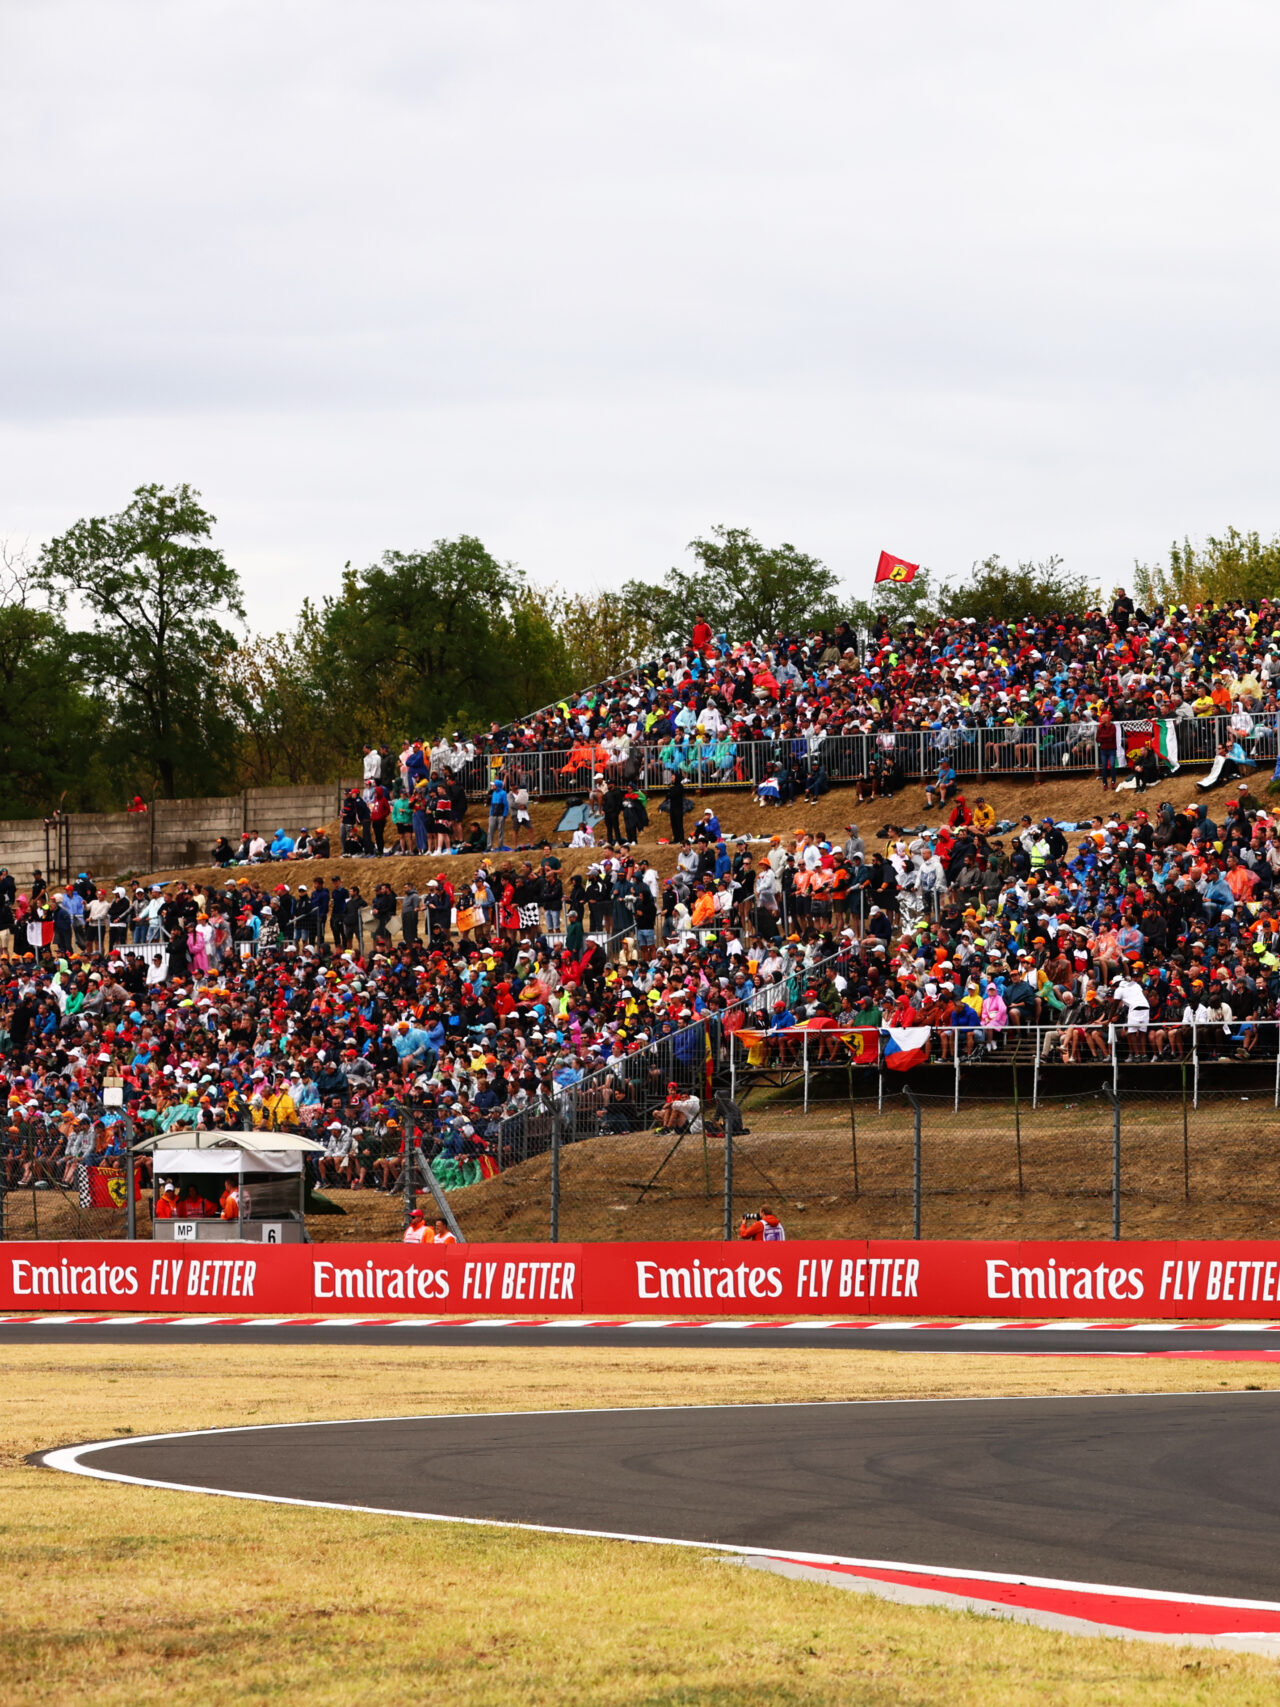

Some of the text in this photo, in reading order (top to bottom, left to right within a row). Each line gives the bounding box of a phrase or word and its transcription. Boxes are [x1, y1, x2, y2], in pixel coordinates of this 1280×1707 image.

[178, 1225, 193, 1236] MP
[268, 1228, 276, 1243] 6
[12, 1257, 257, 1296] Emirates FLY BETTER
[313, 1260, 575, 1300] Emirates FLY BETTER
[636, 1259, 919, 1299] Emirates FLY BETTER
[986, 1258, 1145, 1300] Emirates
[1160, 1260, 1201, 1300] FLY
